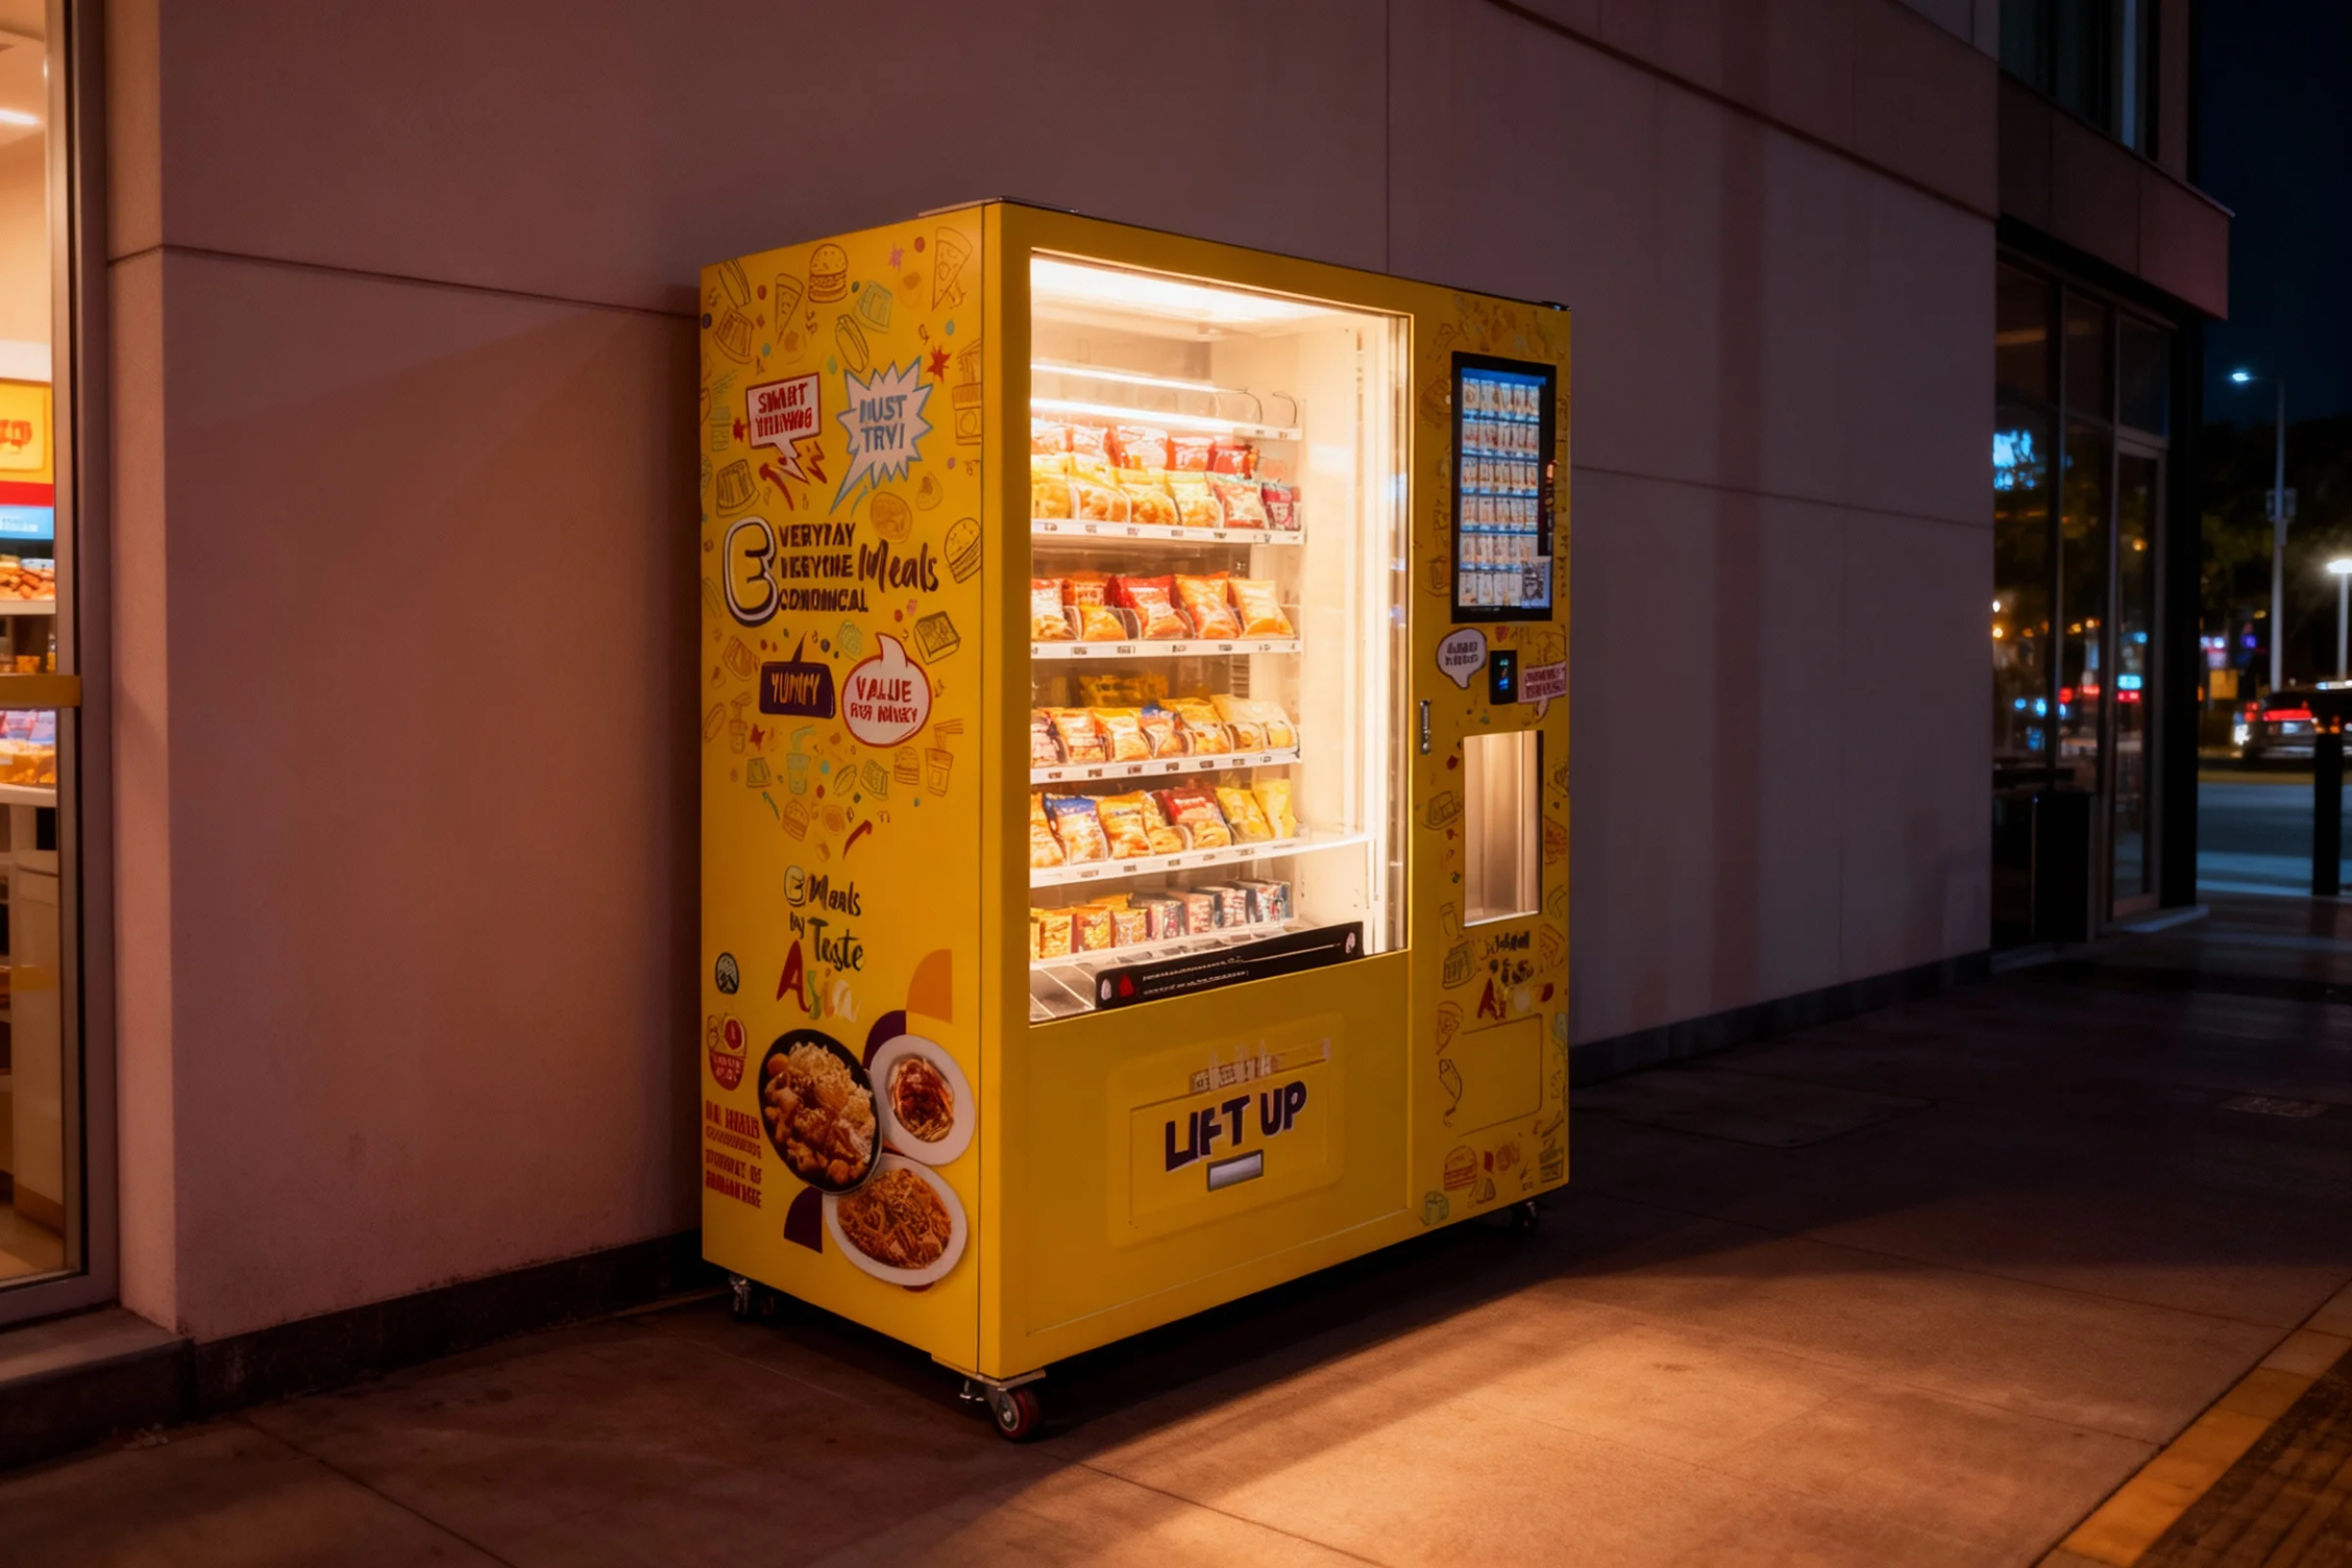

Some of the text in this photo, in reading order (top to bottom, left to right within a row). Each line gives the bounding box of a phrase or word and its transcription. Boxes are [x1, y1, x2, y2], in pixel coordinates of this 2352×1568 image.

[858, 539, 939, 594] Meals
[776, 939, 862, 1022] Asia
[1260, 1080, 1307, 1136] UP
